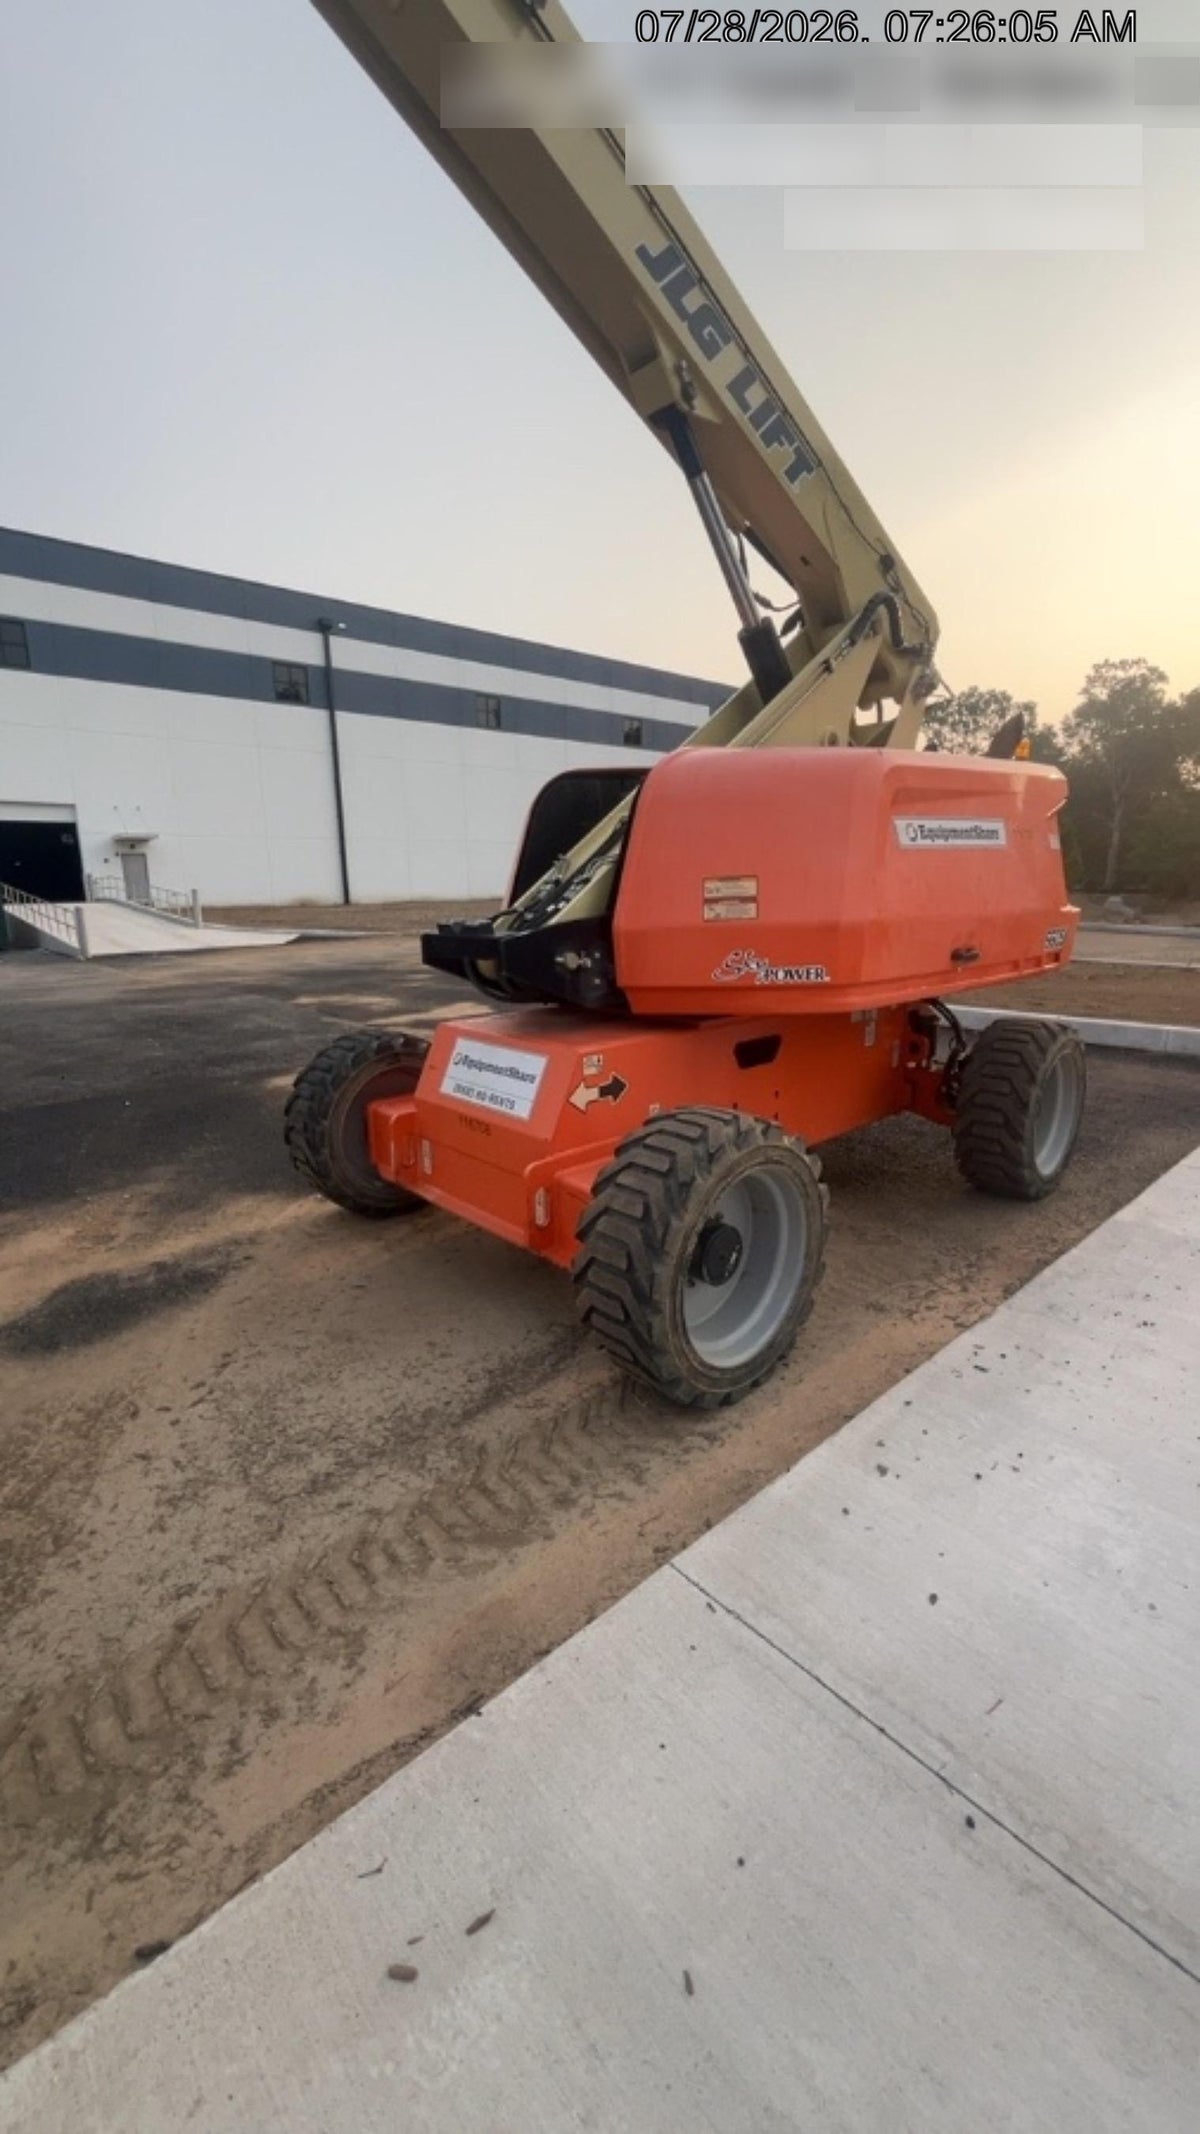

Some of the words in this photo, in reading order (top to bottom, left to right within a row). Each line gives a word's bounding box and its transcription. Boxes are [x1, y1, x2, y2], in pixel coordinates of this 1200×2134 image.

[635, 243, 732, 362] JLG
[725, 363, 816, 487] LIFT
[762, 965, 827, 984] POWER
